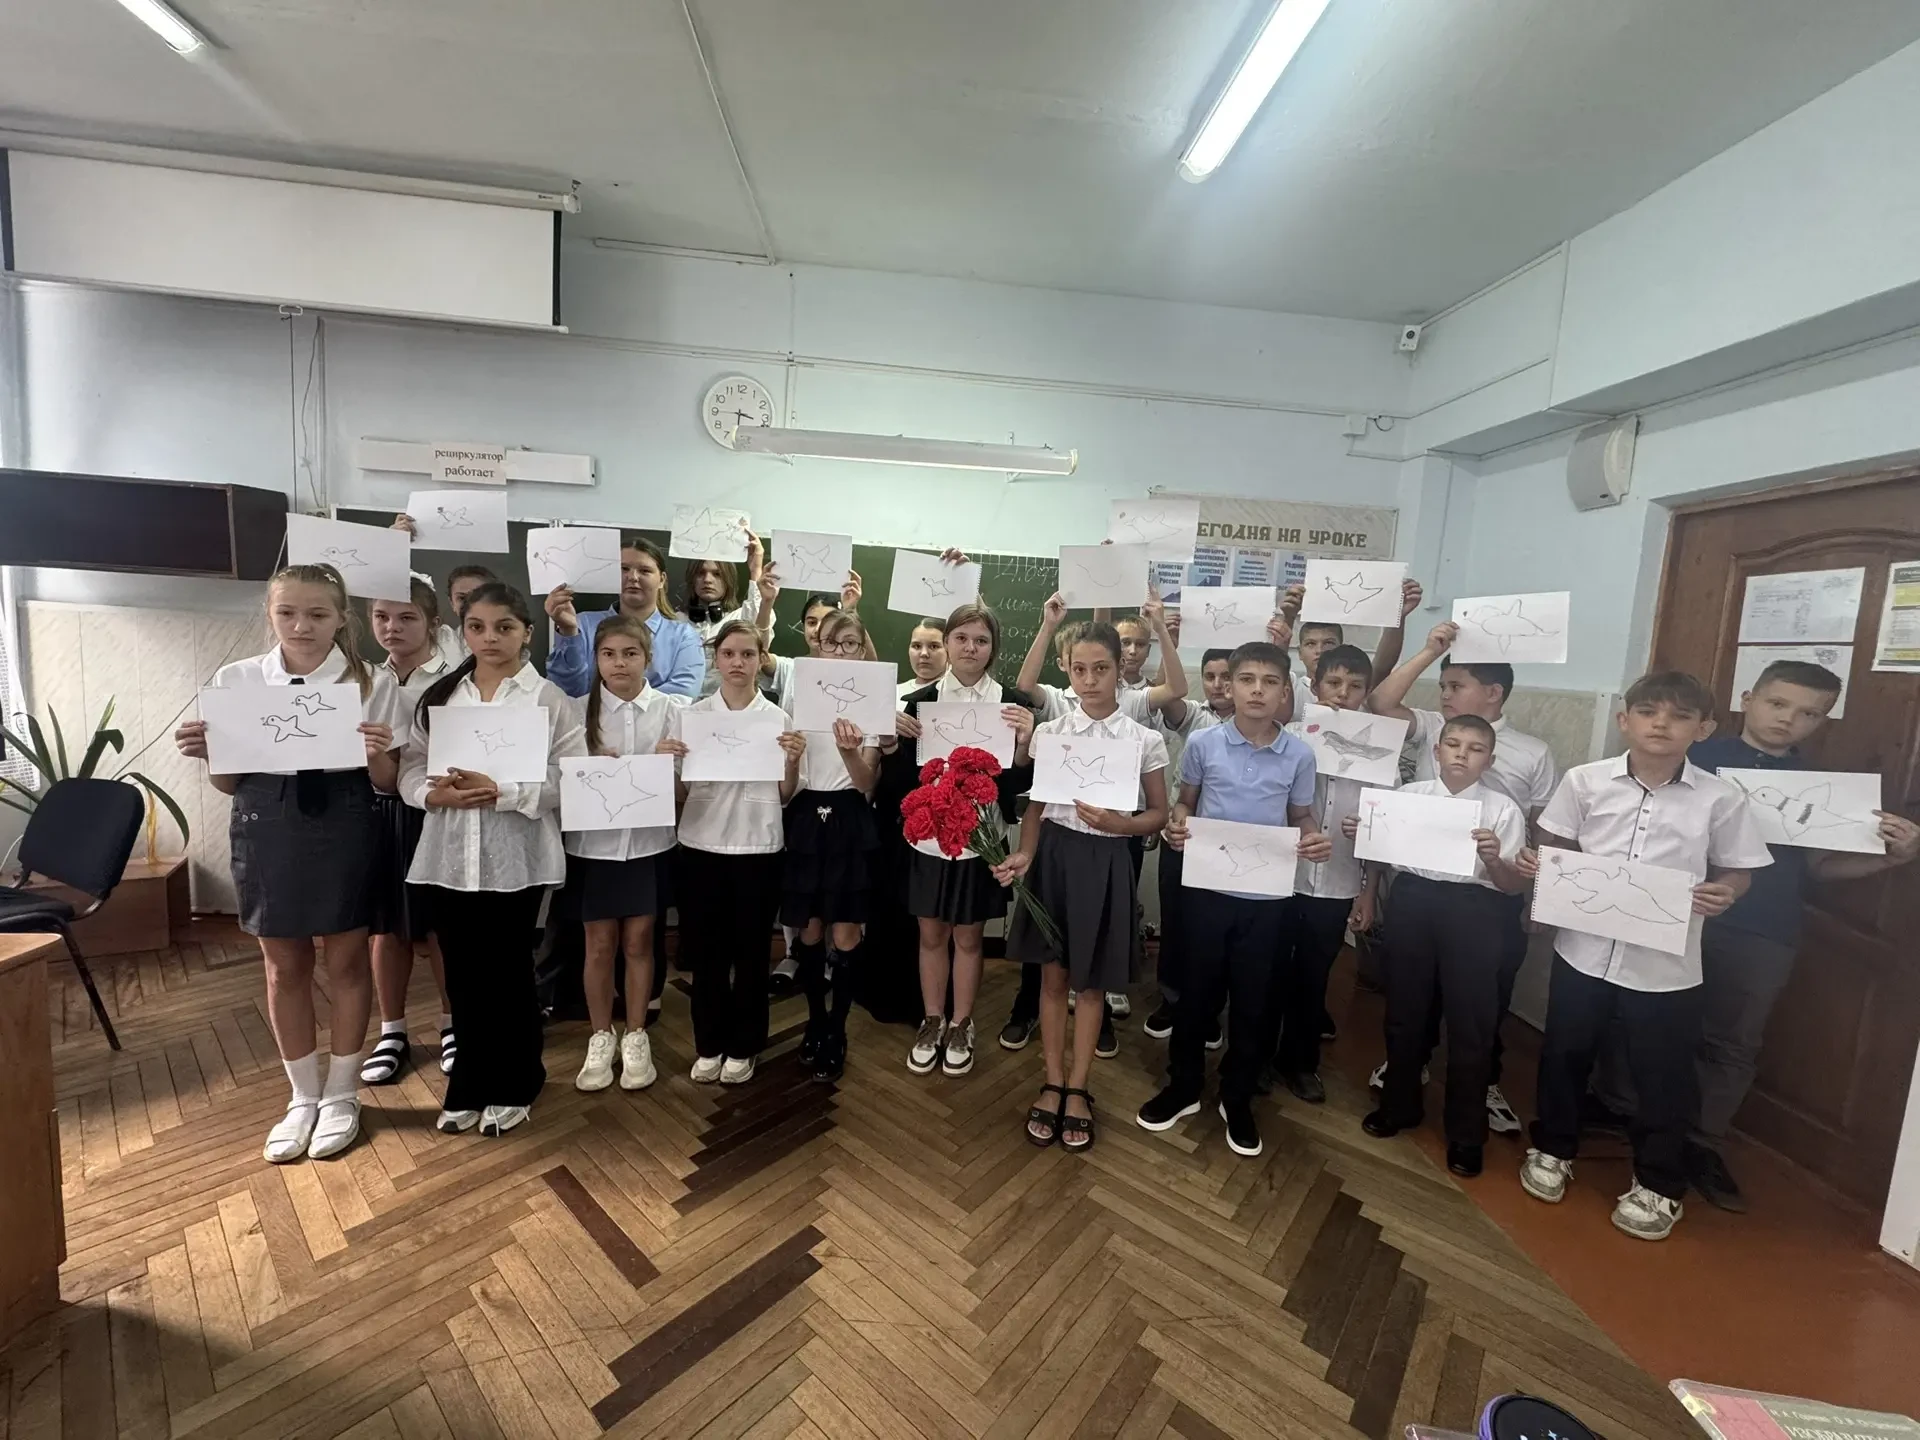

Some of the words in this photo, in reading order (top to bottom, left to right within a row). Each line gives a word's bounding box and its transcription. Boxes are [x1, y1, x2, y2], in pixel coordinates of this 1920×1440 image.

[725, 386, 733, 396] 11
[737, 384, 748, 394] 12
[752, 389, 756, 399] 1
[715, 394, 726, 404] 10
[759, 400, 767, 409] 2
[711, 407, 719, 416] 9
[761, 413, 769, 423] 3
[714, 420, 722, 429] 8
[723, 430, 730, 440] 7
[444, 465, 495, 478] работает
[1196, 522, 1272, 541] ЕГОДНЯ
[1277, 527, 1302, 544] НА
[1307, 529, 1368, 548] УРОКЕ
